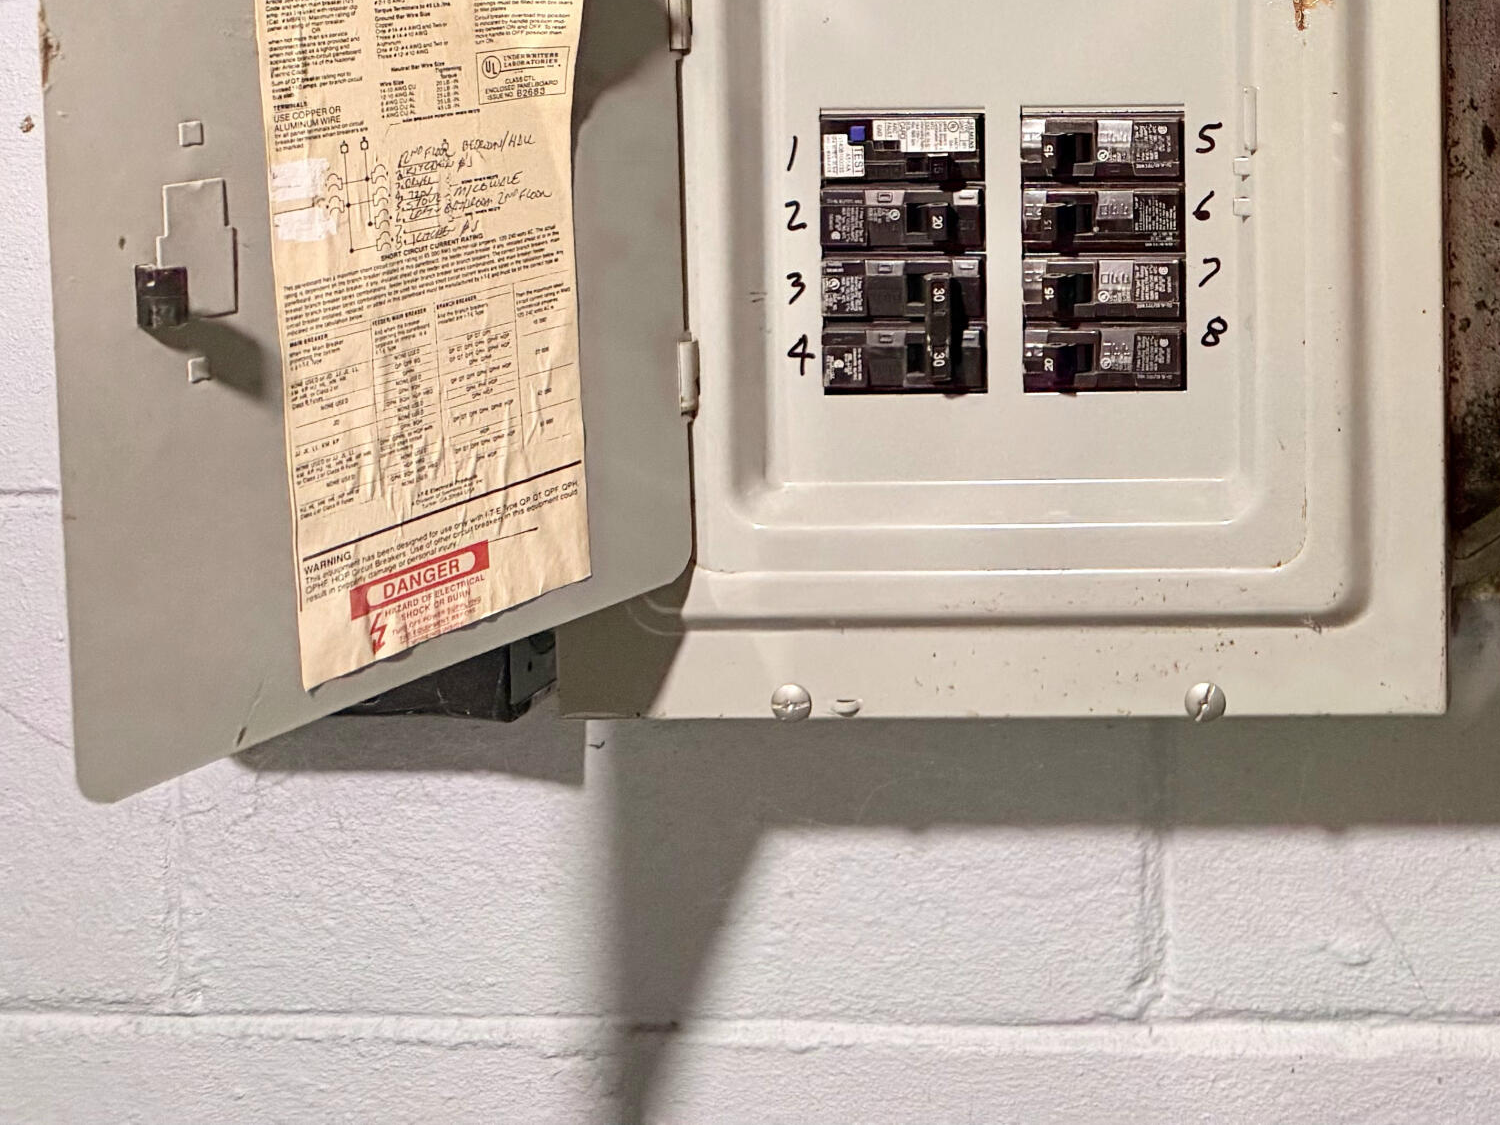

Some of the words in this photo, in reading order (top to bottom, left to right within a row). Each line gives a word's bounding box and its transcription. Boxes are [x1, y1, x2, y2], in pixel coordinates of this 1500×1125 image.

[274, 113, 290, 122] USE
[292, 107, 327, 119] COPPER
[329, 106, 341, 114] OR
[275, 119, 318, 132] ALUMINUM
[320, 115, 341, 124] WIRE
[1044, 144, 1054, 157] 15
[1196, 122, 1222, 154] 5
[787, 136, 798, 171] 1
[855, 148, 863, 173] TEST
[785, 202, 807, 230] 2
[1192, 192, 1214, 221] 6
[932, 216, 943, 228] 20
[1199, 258, 1221, 287] 7
[786, 273, 806, 305] 3
[933, 287, 945, 302] 30
[1044, 287, 1054, 300] 15
[1201, 317, 1228, 346] 8
[787, 335, 816, 375] 4
[933, 353, 945, 367] 30
[1044, 358, 1054, 371] 20
[304, 551, 351, 573] WARNING
[383, 558, 460, 599] DANGER
